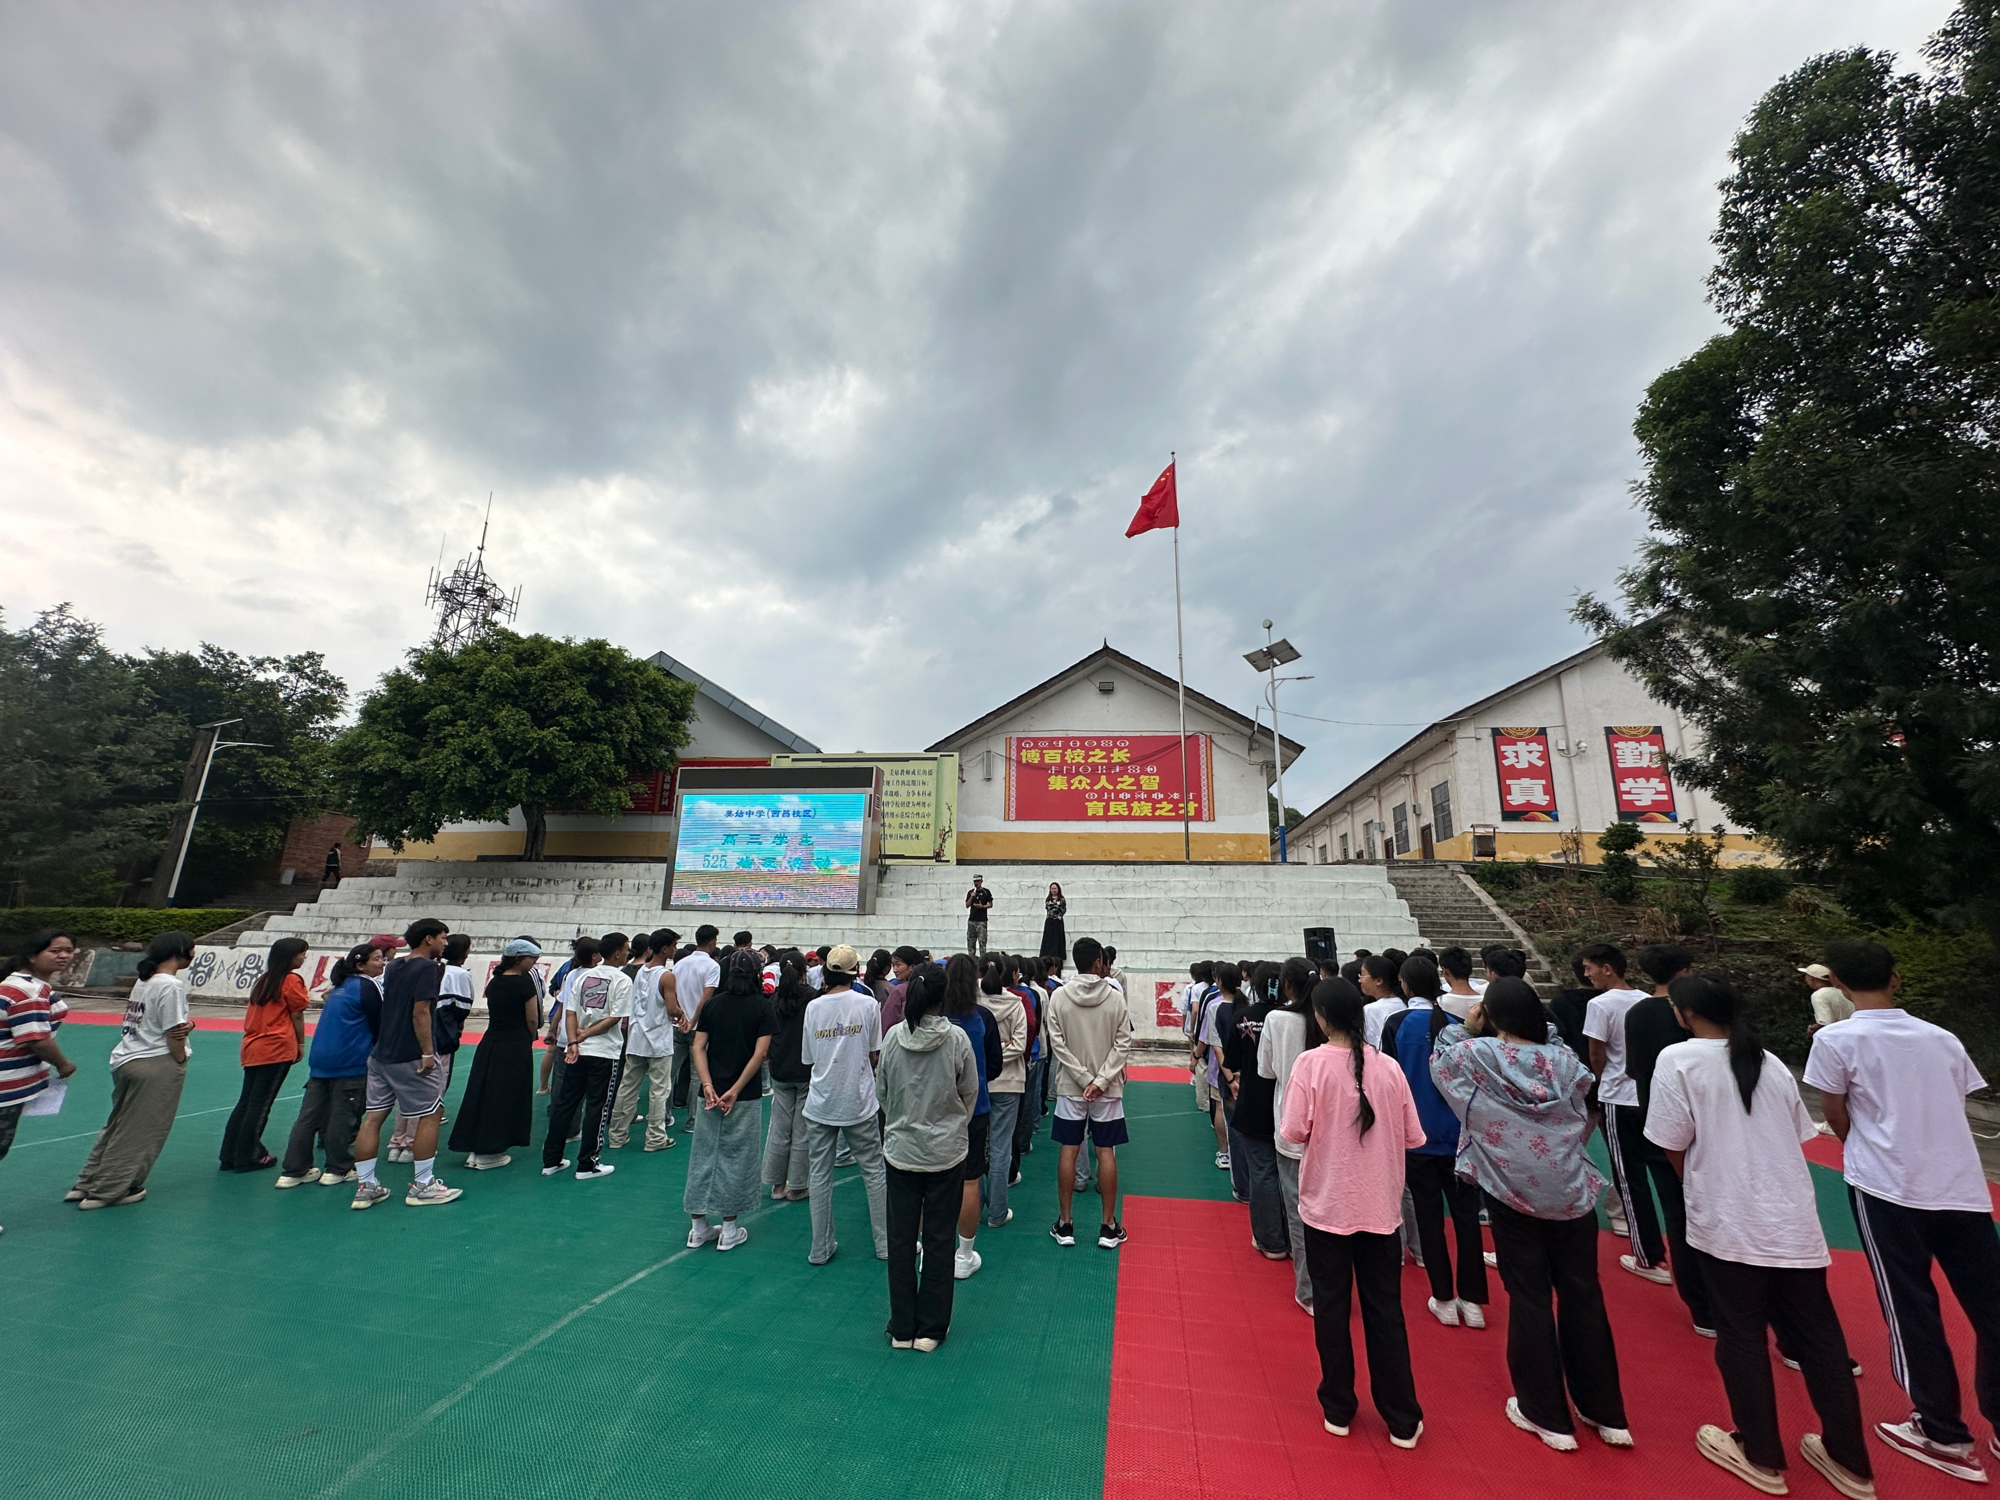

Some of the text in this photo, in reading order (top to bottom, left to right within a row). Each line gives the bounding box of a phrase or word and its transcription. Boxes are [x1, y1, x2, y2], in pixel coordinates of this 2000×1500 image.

[1020, 748, 1131, 764] 博百校之长
[1500, 741, 1549, 806] 求真
[1613, 741, 1668, 806] 勤学
[1047, 775, 1160, 791] 集众人之智
[1085, 801, 1199, 817] 育民族之才
[721, 833, 814, 846] 高三学生
[703, 854, 728, 869] 525
